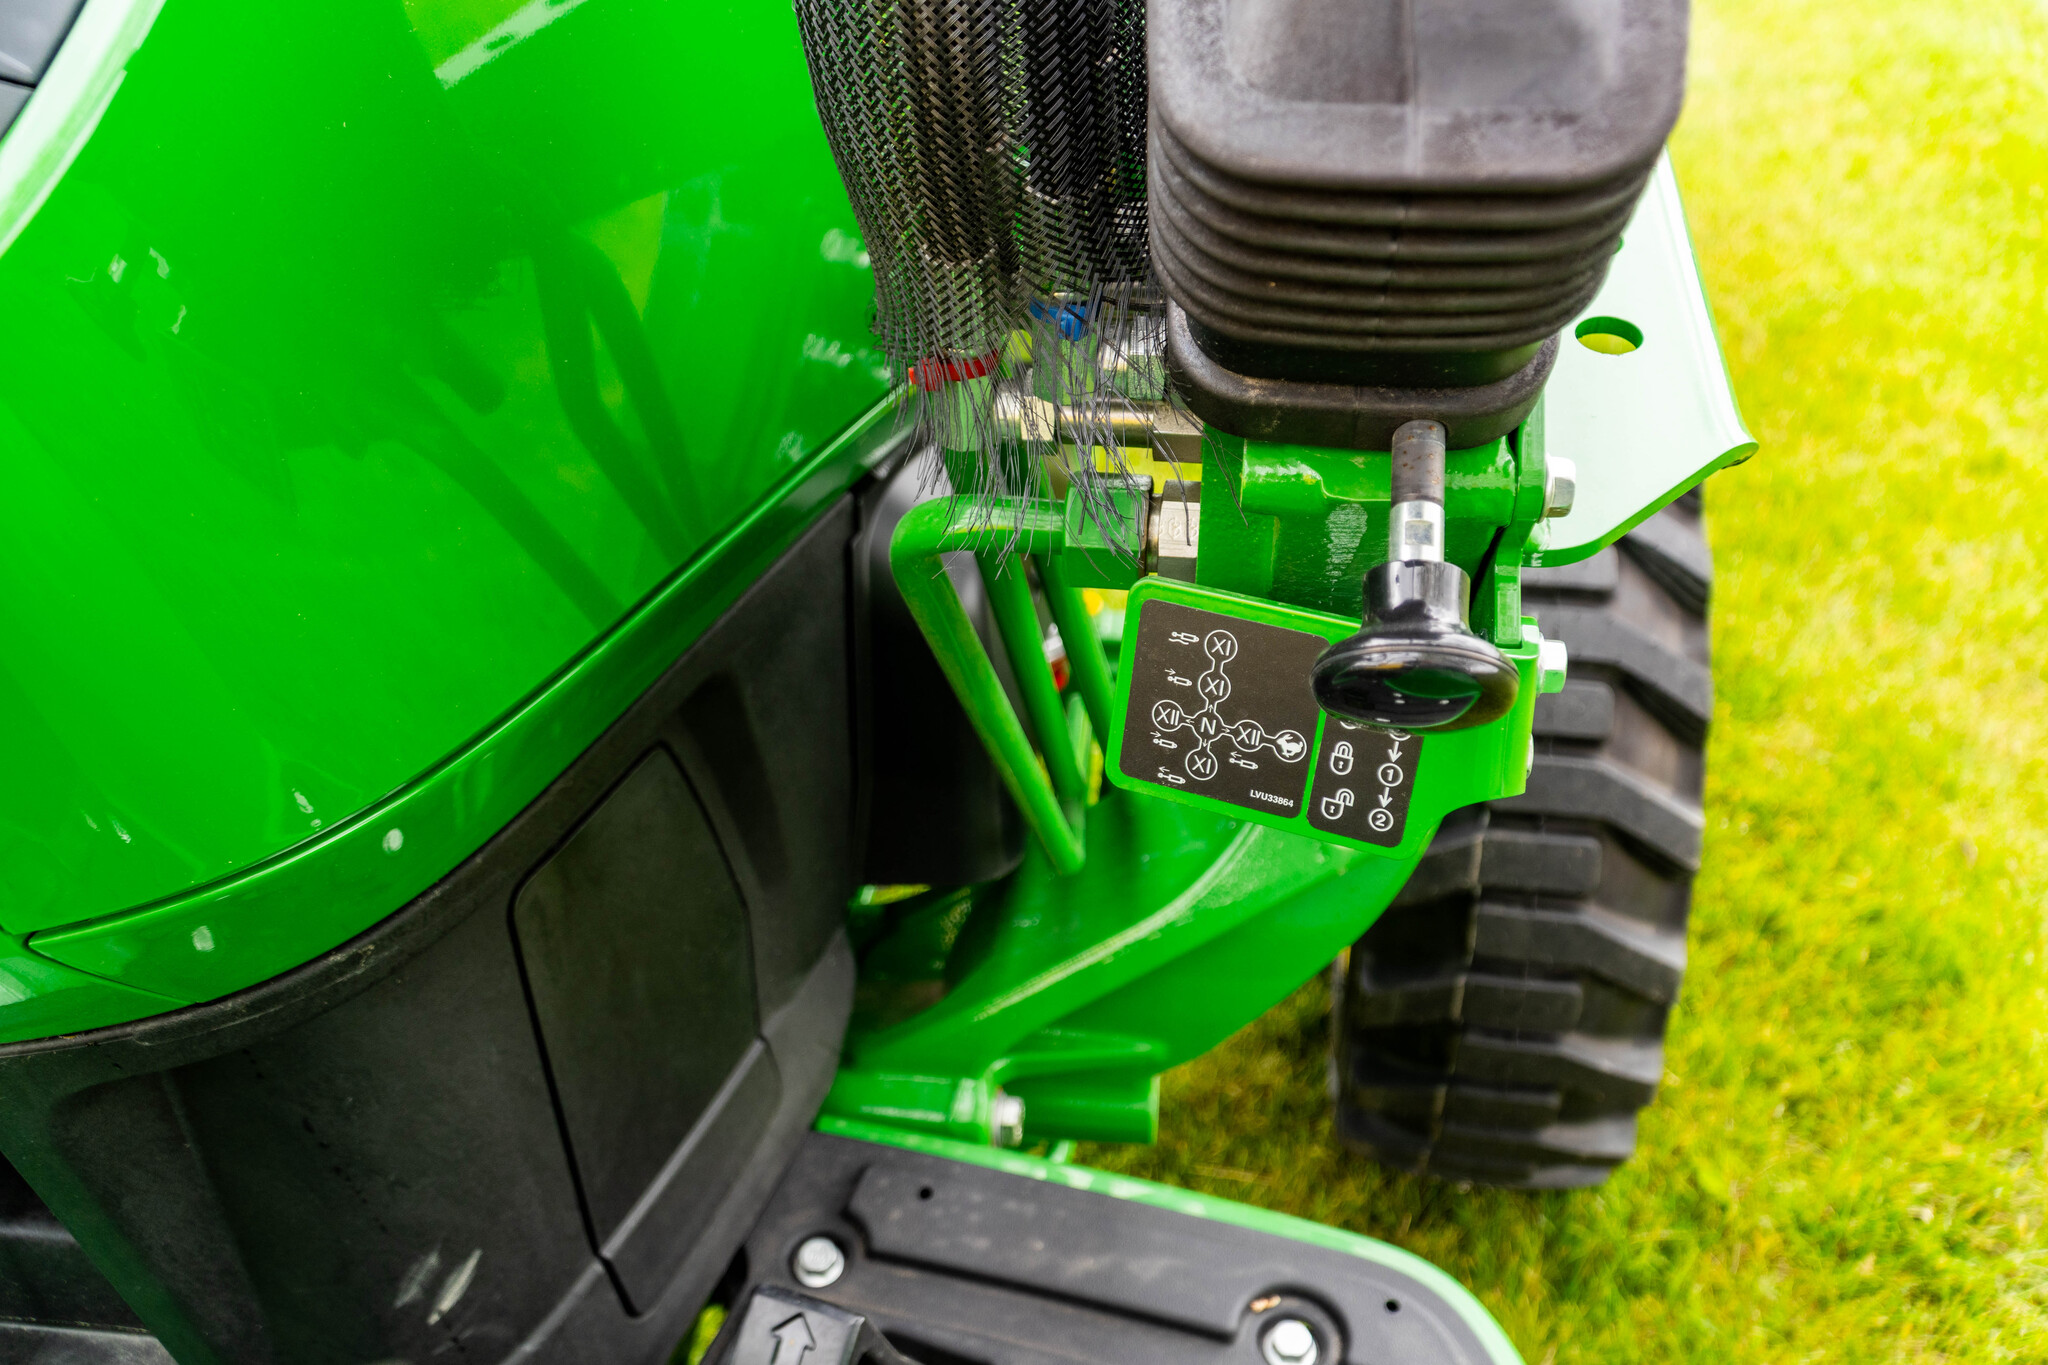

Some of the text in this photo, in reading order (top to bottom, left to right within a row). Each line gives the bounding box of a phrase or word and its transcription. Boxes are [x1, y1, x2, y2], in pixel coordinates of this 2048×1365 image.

[1211, 637, 1232, 656] XI
[1205, 676, 1226, 696] XI
[1156, 706, 1180, 726] XII
[1200, 717, 1217, 735] N
[1237, 727, 1261, 747] XII
[1192, 755, 1212, 774] XI
[1386, 768, 1396, 782] 1
[1250, 789, 1294, 808] LVU33864
[1375, 813, 1387, 827] 2
